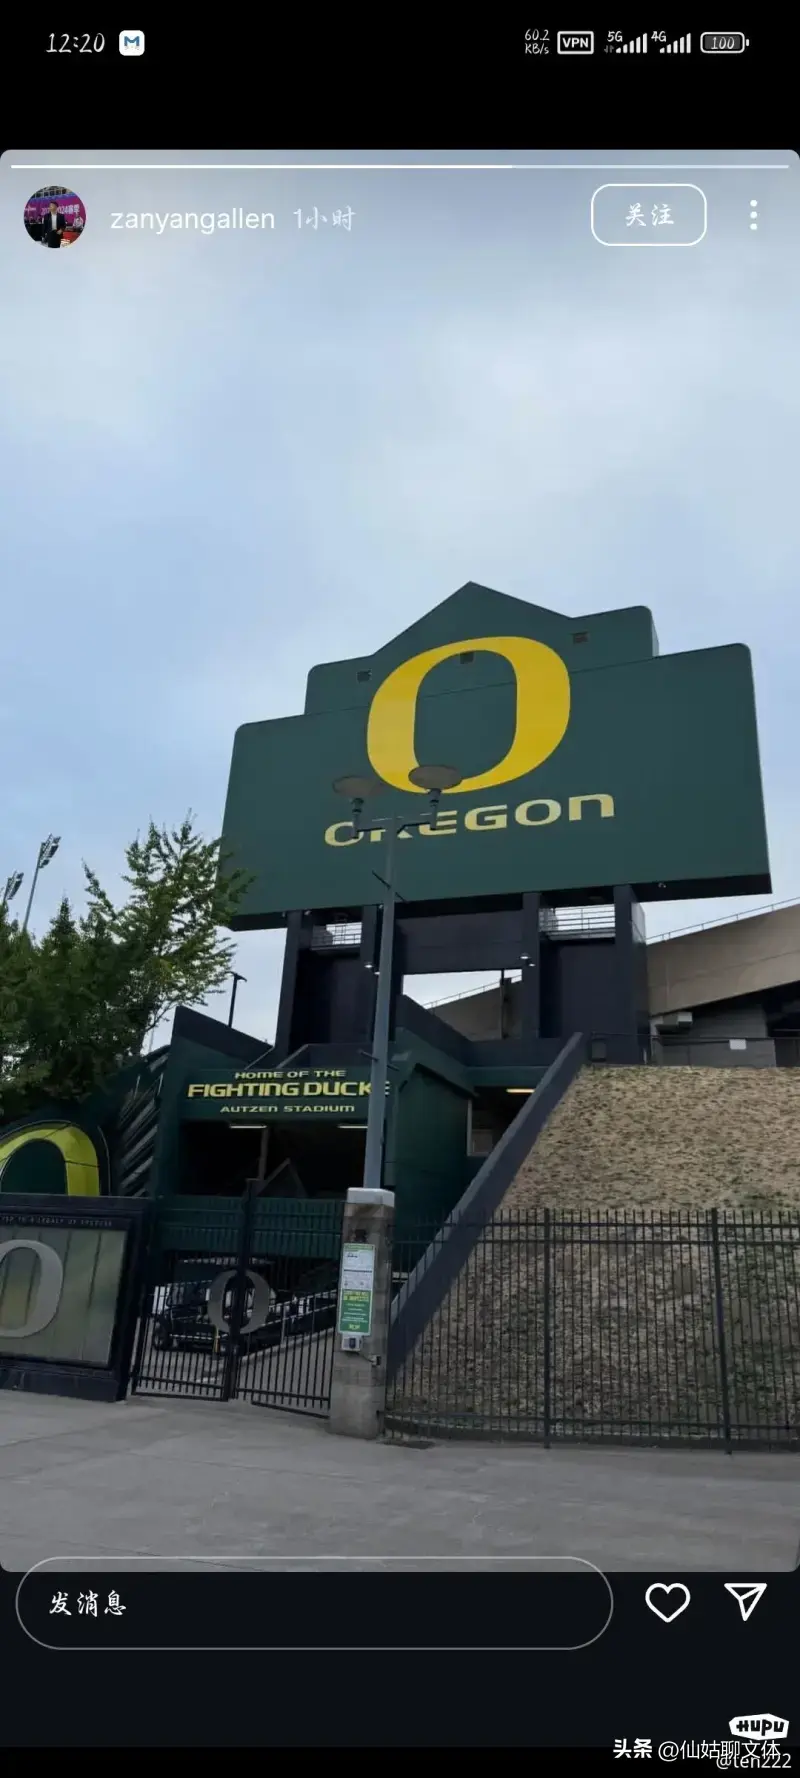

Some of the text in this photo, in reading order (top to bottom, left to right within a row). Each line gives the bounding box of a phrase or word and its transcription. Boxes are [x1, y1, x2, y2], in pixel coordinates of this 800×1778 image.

[366, 635, 571, 794] O
[234, 1069, 346, 1080] HOME OF THE
[187, 1080, 391, 1098] FIGHTING DUCK
[220, 1105, 355, 1113] AUTZEN STADIUM
